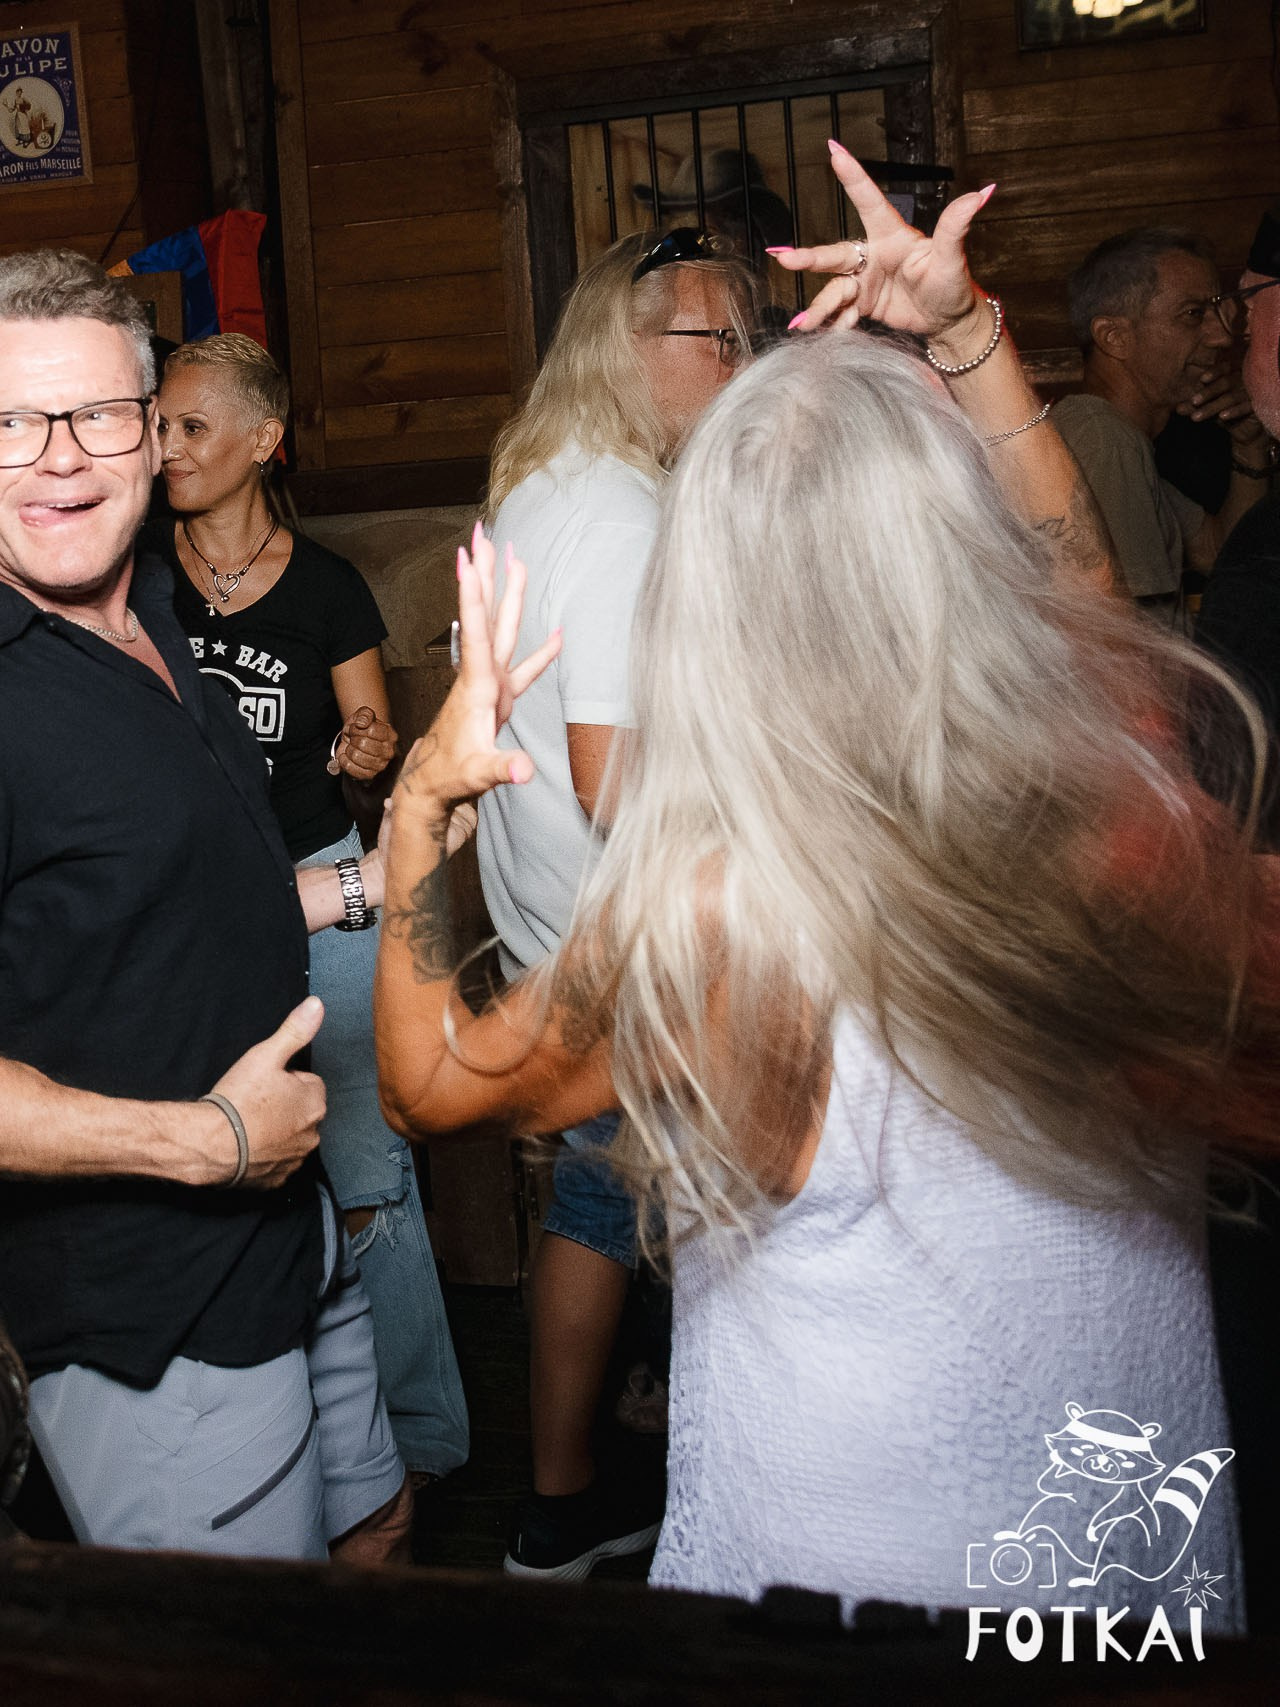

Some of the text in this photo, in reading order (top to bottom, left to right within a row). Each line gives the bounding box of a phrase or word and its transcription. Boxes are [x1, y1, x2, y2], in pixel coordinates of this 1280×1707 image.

[25, 161, 39, 170] FILS
[40, 157, 81, 170] MARSEILLE
[235, 644, 288, 683] BAR
